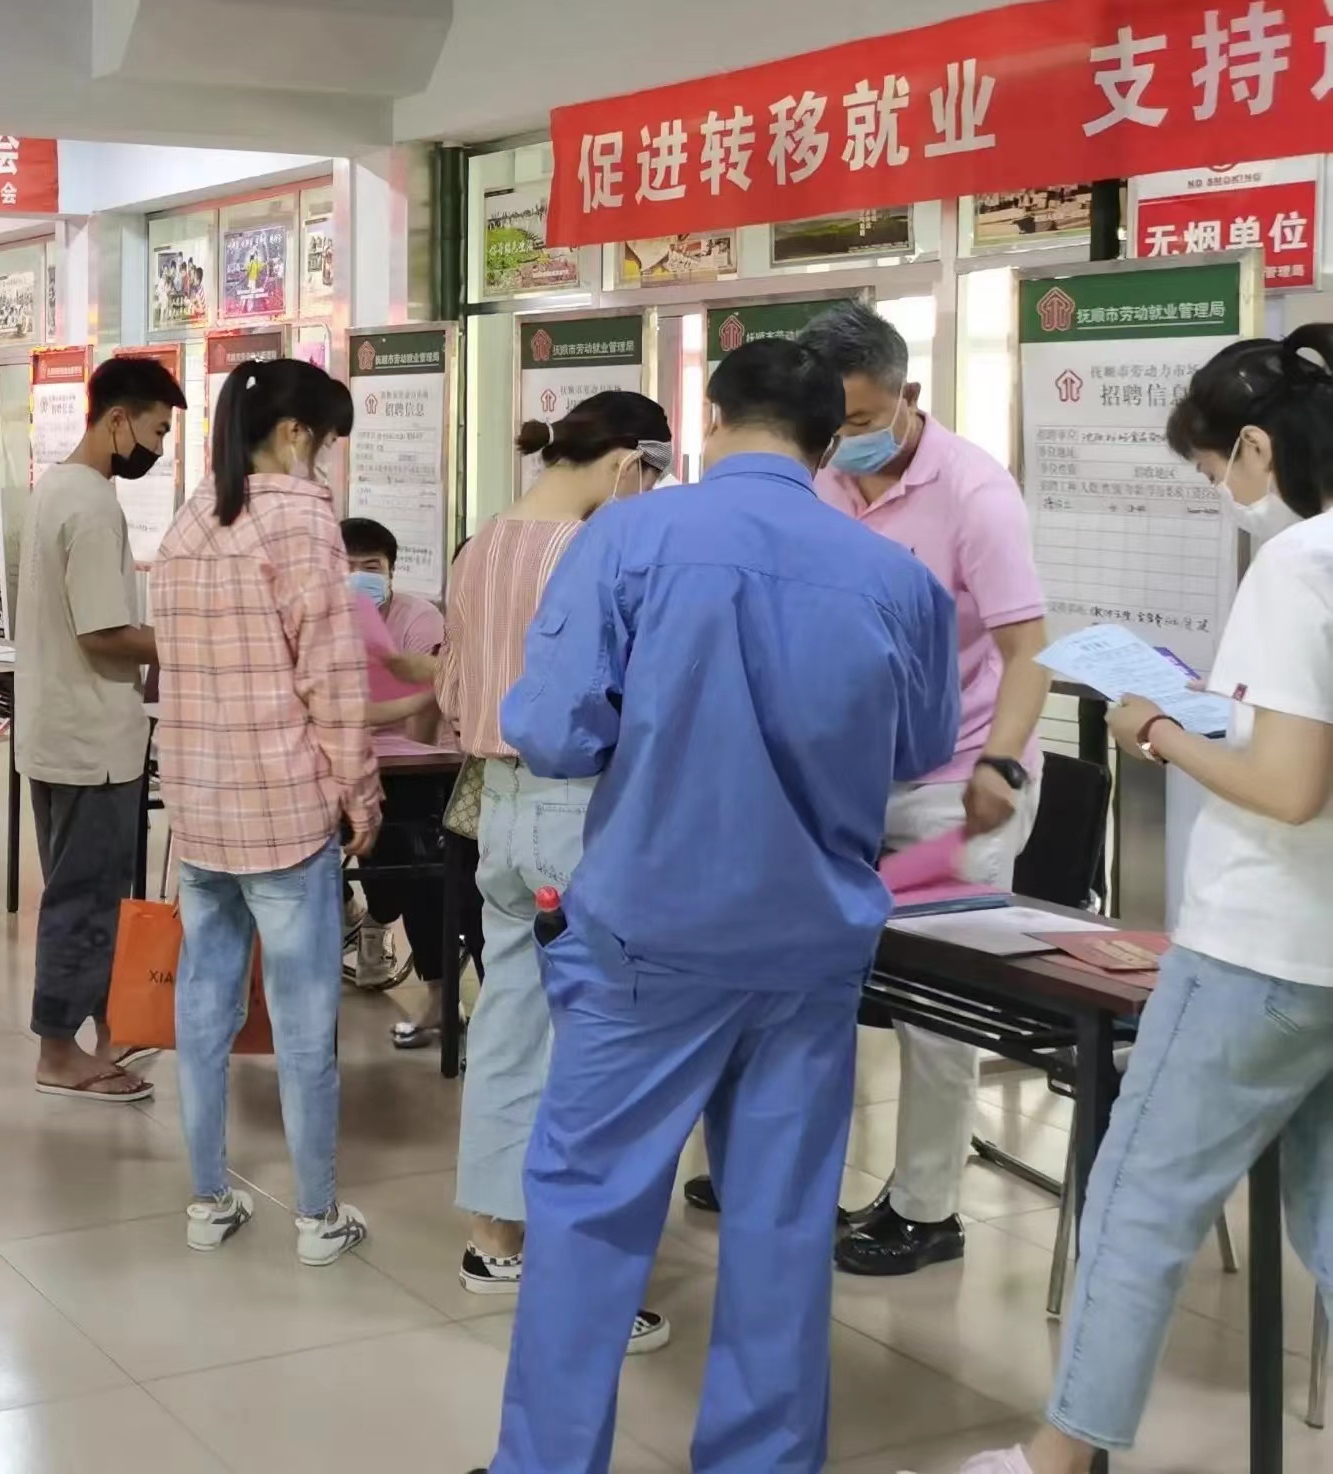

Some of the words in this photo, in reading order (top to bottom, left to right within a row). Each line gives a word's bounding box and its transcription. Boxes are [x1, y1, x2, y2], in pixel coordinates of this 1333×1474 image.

[578, 58, 996, 214] 促进转移就业
[1187, 178, 1203, 189] NO
[1207, 172, 1262, 187] SMOKING
[1144, 210, 1308, 258] 无烟单位
[1076, 300, 1226, 325] 抚顺市劳动就业管理局
